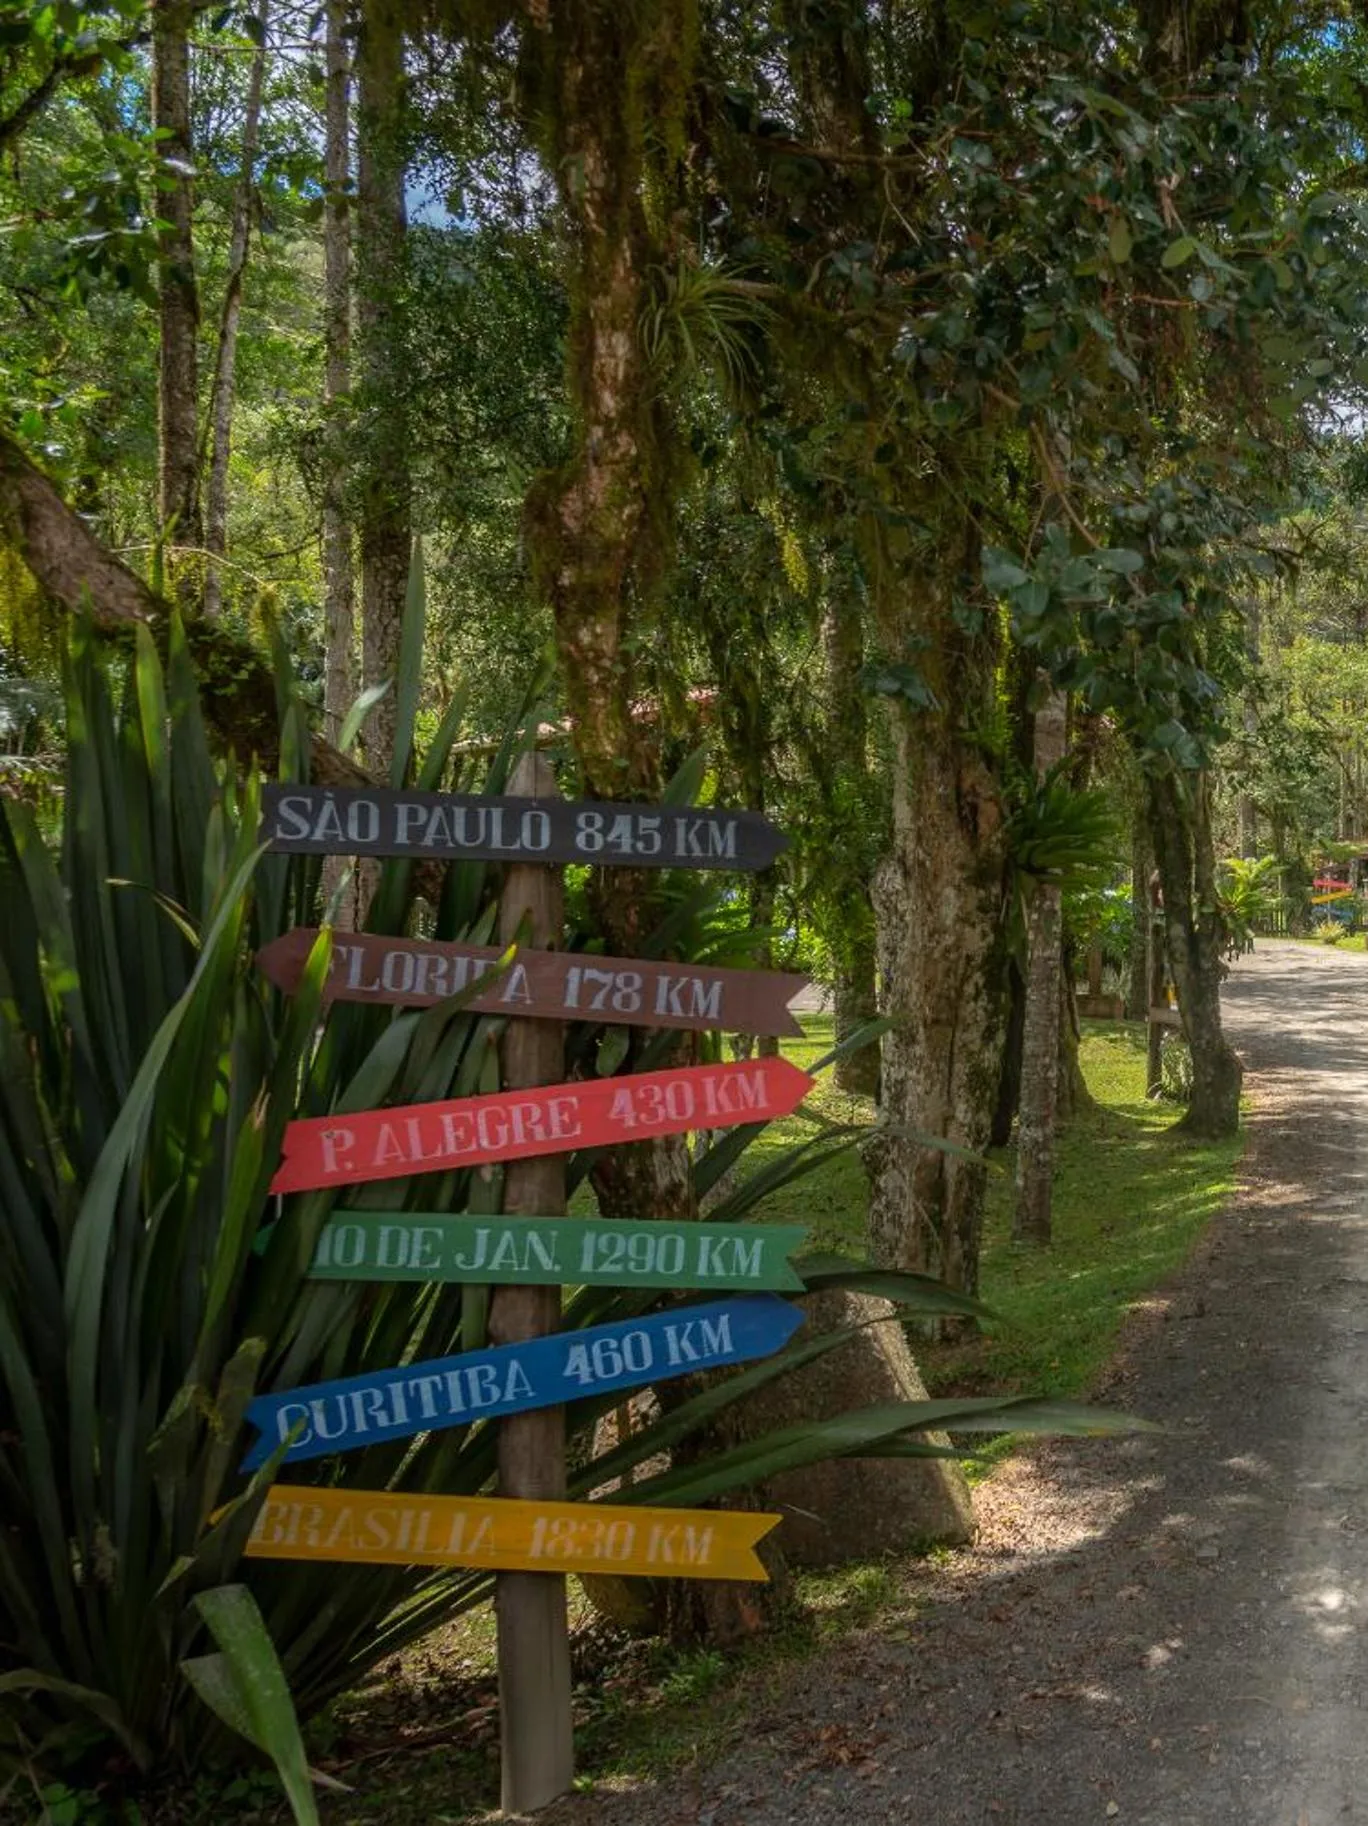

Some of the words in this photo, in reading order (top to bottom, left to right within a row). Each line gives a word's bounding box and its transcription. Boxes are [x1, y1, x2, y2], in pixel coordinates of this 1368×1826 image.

[393, 804, 552, 851] PAULO
[574, 810, 663, 855] 845
[674, 816, 738, 859] KM
[331, 945, 534, 1004] LORIA
[564, 965, 641, 1012] 178
[654, 975, 723, 1020] KM
[371, 1096, 582, 1166] ALEGRE
[608, 1080, 693, 1128] 430
[704, 1069, 769, 1114] KM
[375, 1225, 445, 1270] DE
[455, 1227, 562, 1273] JAN.
[579, 1232, 686, 1276] 1290
[698, 1235, 766, 1278] KM
[275, 1358, 537, 1449] CURITIBA
[561, 1330, 653, 1386] 460
[663, 1313, 734, 1367] KM
[527, 1515, 638, 1561] 1830
[648, 1521, 714, 1566] KM
